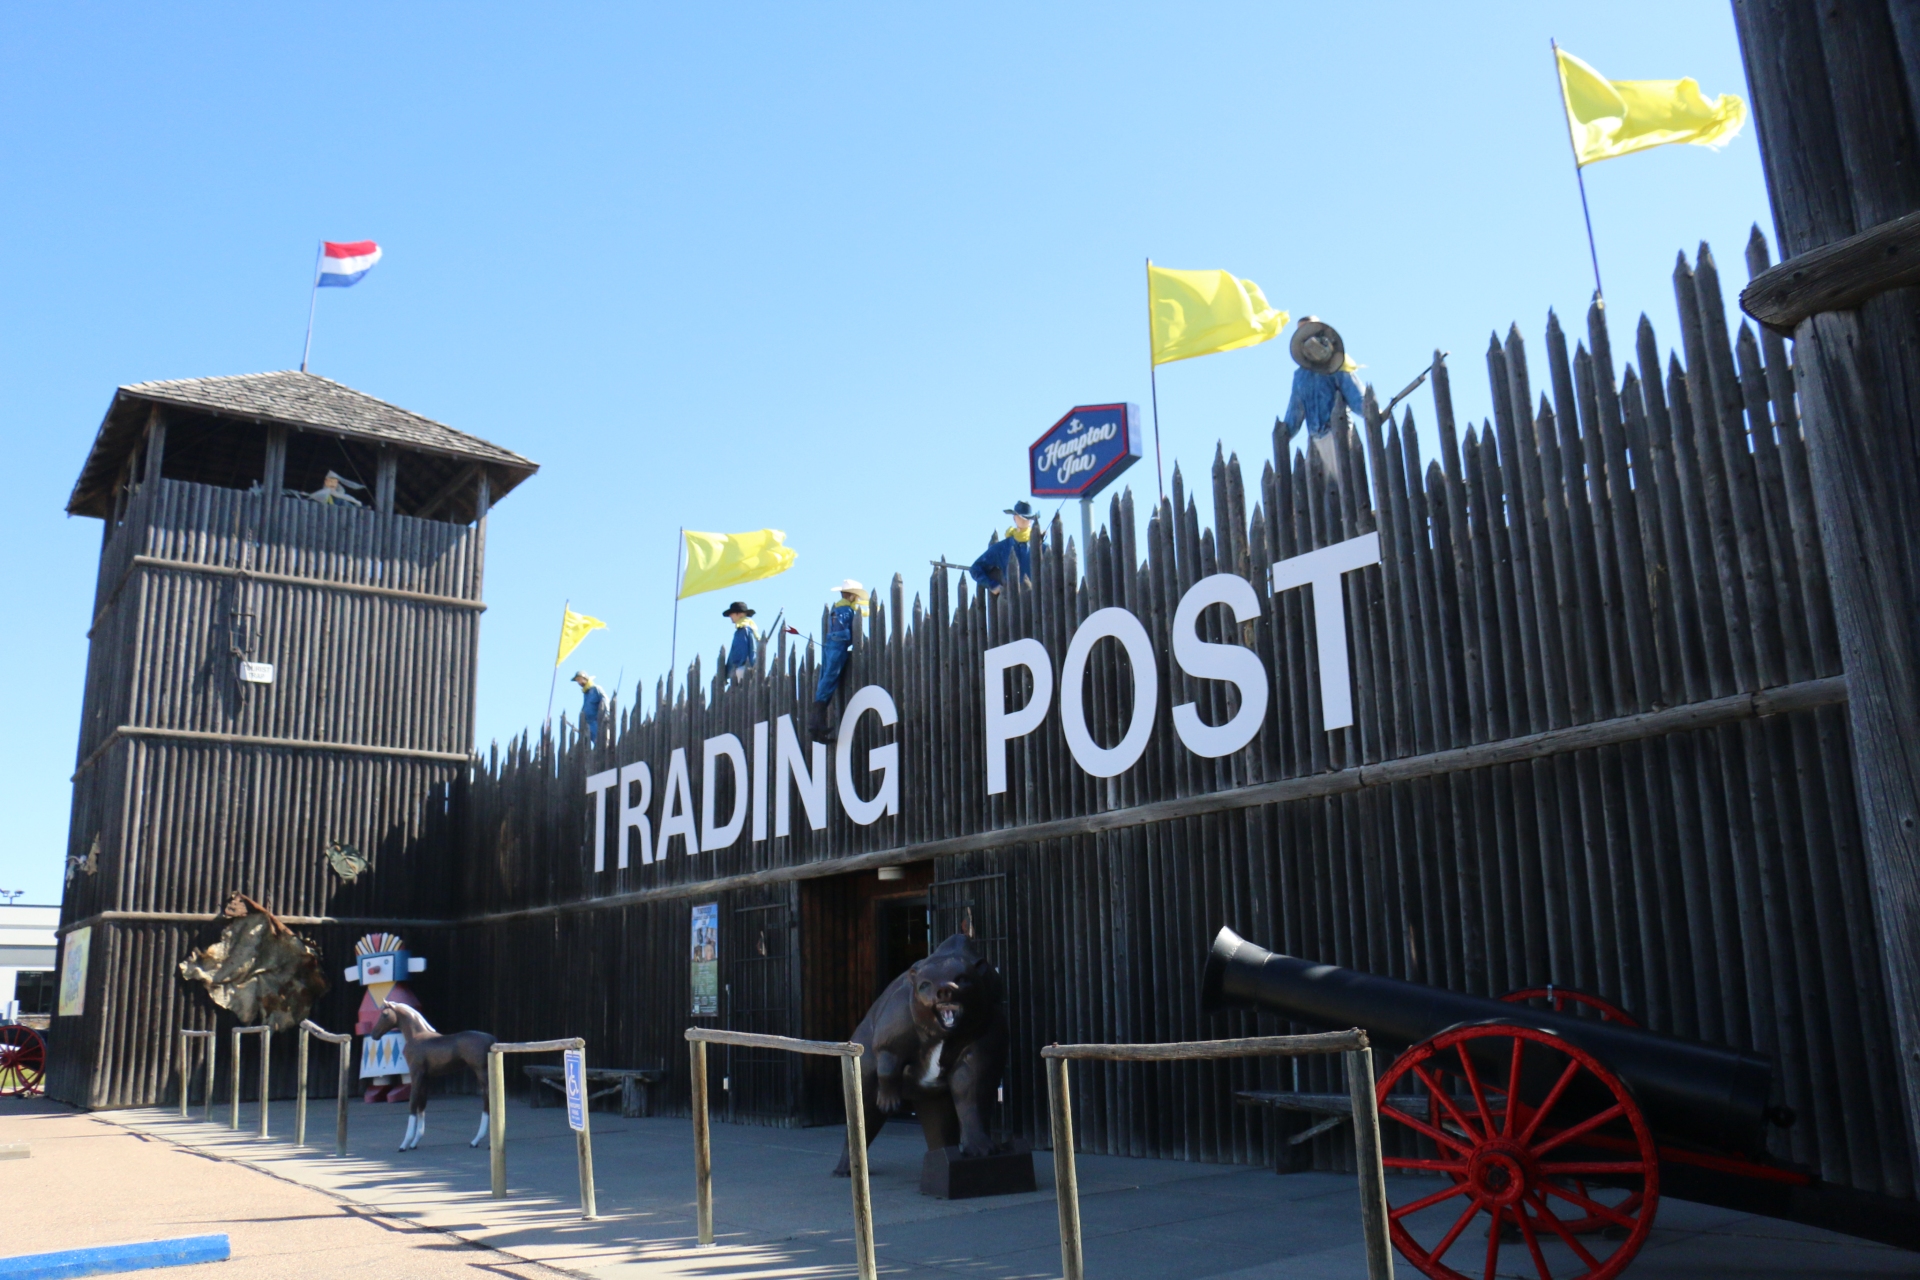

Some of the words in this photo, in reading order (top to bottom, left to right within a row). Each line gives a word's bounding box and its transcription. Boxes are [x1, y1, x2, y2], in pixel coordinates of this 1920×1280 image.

[1037, 422, 1117, 471] Hampton
[1057, 454, 1097, 484] Inn
[586, 685, 899, 873] TRADING
[984, 531, 1381, 796] POST
